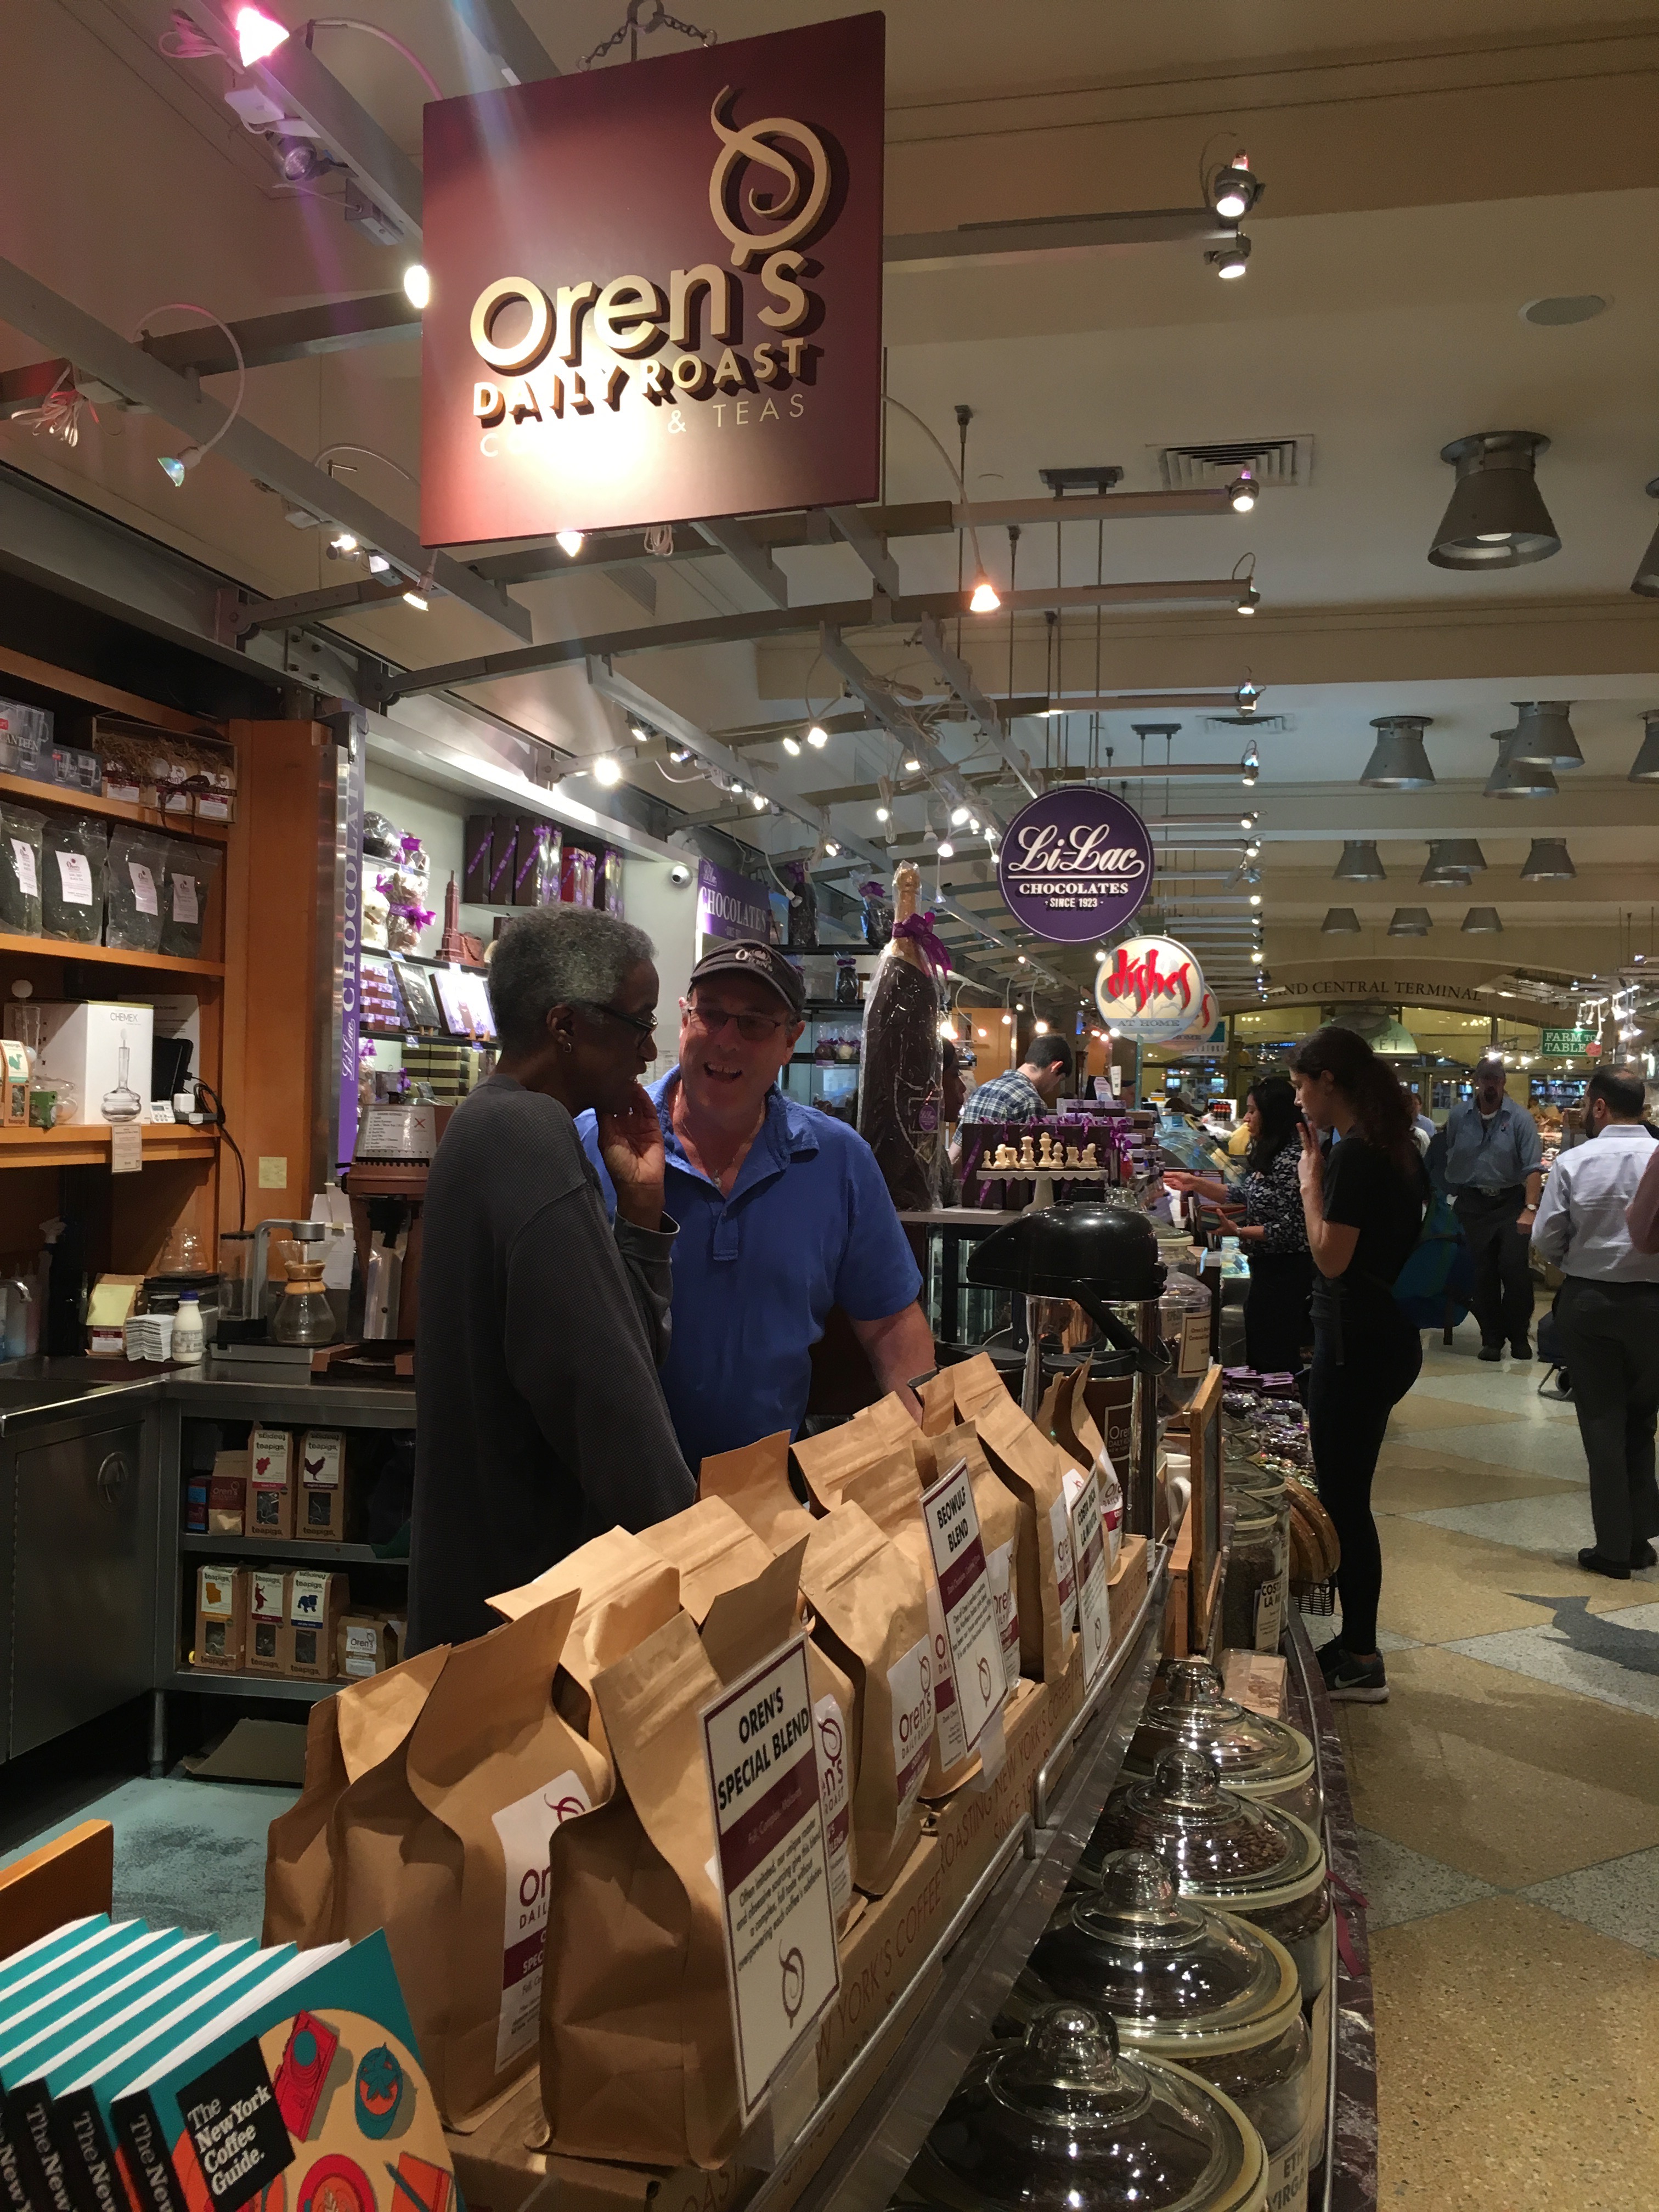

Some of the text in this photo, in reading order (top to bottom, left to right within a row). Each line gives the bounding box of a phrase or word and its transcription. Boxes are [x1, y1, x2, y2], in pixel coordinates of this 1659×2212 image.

[470, 250, 809, 370] Oren's
[473, 337, 808, 420] DAILY ROAST
[667, 393, 804, 435] & TEAS
[2, 732, 38, 752] ANTEEN
[1008, 824, 1145, 873] Li-Lac
[342, 731, 360, 1012] CHOCOLATE
[1019, 883, 1129, 894] CHOCOLATES
[698, 886, 767, 933] CHOCOLATES
[1049, 898, 1098, 908] SINCE 1923
[1107, 949, 1191, 1012] dishes
[1313, 980, 1389, 994] CENTRAL
[1394, 981, 1482, 1001] TERMINAL
[110, 1012, 138, 1022] CHEMEX
[1545, 1032, 1583, 1042] FARM
[1544, 1042, 1587, 1053] TABLE
[1108, 1440, 1122, 1448] DAILY
[936, 1486, 966, 1530] BEOWULF
[947, 1517, 969, 1553] BLEND
[1264, 1596, 1274, 1608] LA
[351, 1638, 374, 1648] Oren's
[739, 1686, 784, 1744] OREN'S
[899, 1692, 932, 1742] Oren's
[718, 1707, 810, 1810] SPECIAL BLEND
[520, 1902, 546, 1929] DAIL
[522, 1950, 543, 1975] SPEC
[838, 1938, 893, 2025] YORK'S
[895, 1871, 943, 1956] COFFEE
[73, 2111, 98, 2162] The
[187, 2098, 222, 2131] The
[195, 2085, 272, 2154] New York
[27, 2102, 70, 2211] The New
[129, 2113, 156, 2165] The
[204, 2124, 257, 2174] Coffee
[211, 2148, 266, 2196] Guide.
